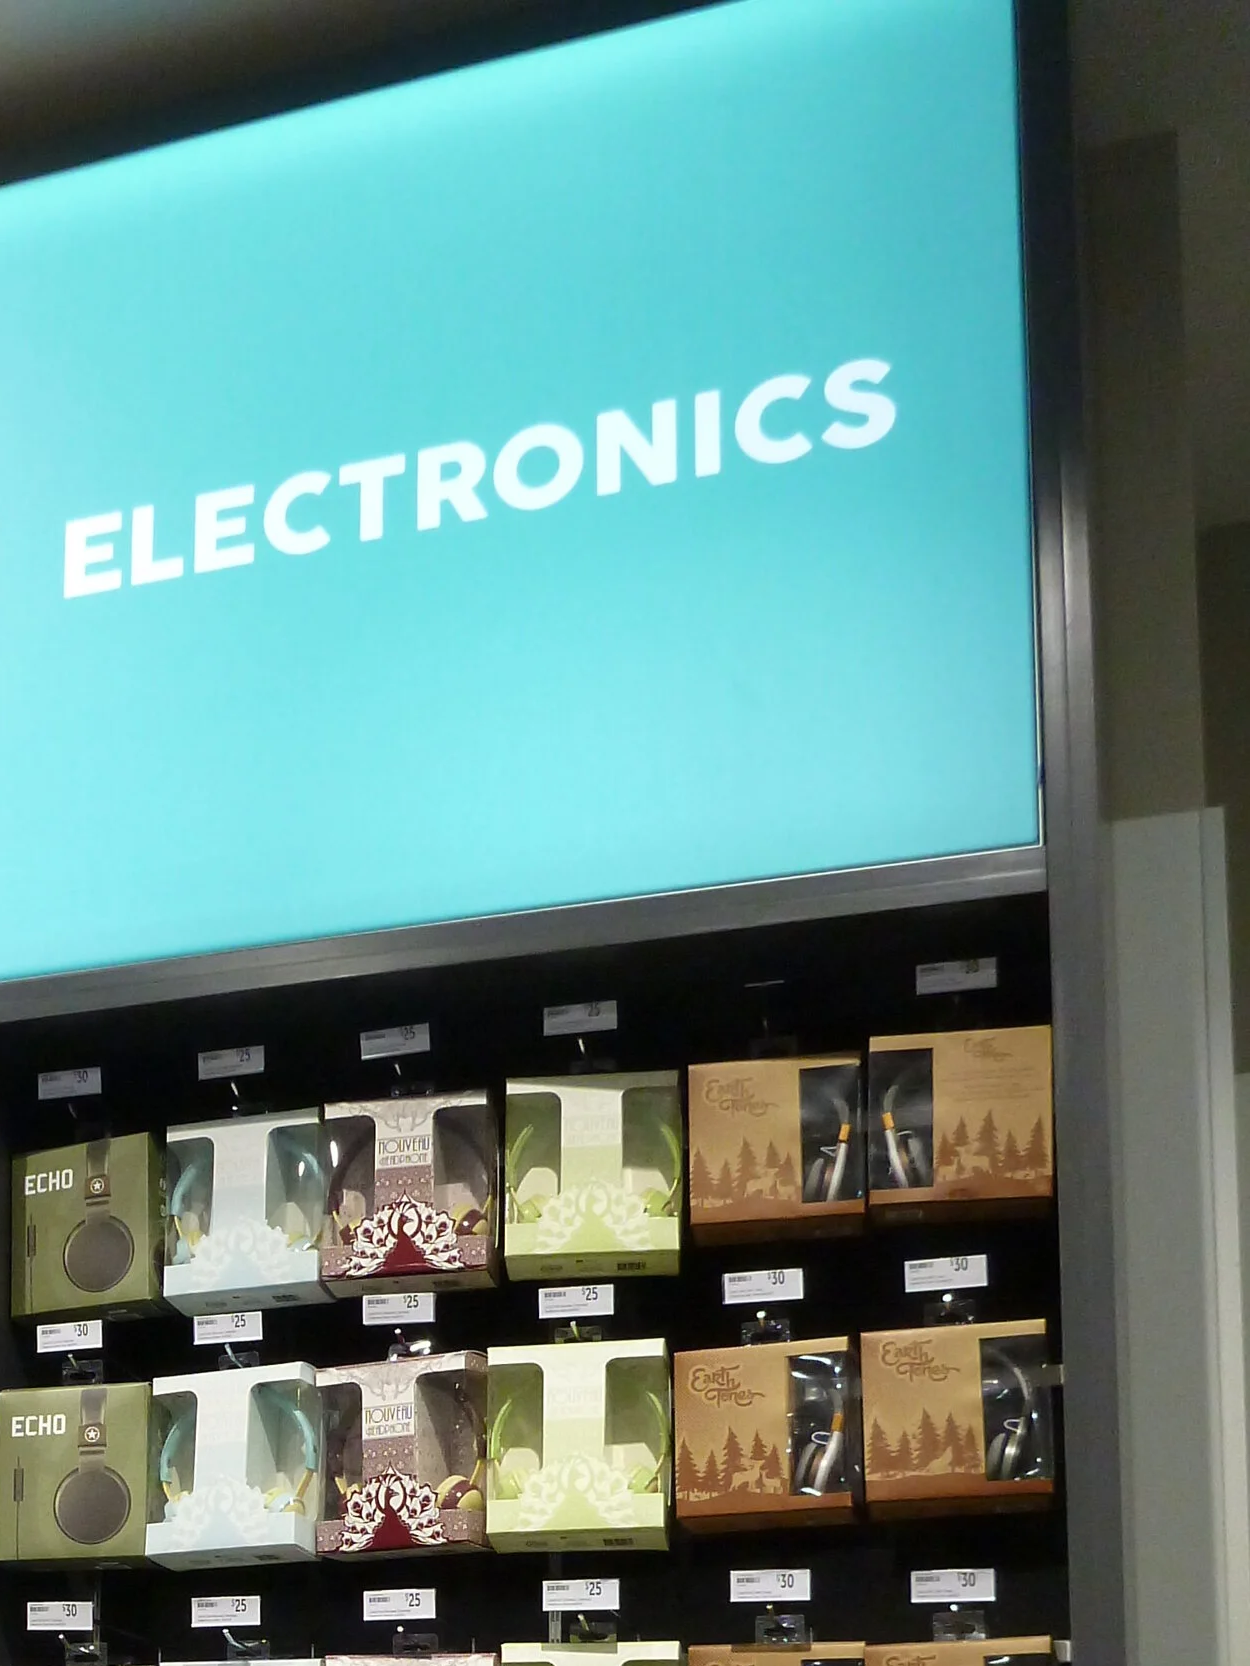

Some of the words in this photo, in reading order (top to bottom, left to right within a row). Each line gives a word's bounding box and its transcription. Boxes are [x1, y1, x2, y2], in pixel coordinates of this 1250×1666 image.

[63, 358, 898, 599] ELECTRONICS
[378, 1137, 430, 1155] NOUVEAU
[24, 1168, 74, 1197] ECHO
[767, 1270, 785, 1285] $30
[582, 1286, 598, 1301] $25
[403, 1295, 419, 1309] $25
[231, 1314, 246, 1328] $25
[73, 1323, 89, 1337] $30
[881, 1340, 935, 1364] Earth
[691, 1366, 741, 1390] Earth
[896, 1362, 961, 1382] Tones
[705, 1387, 765, 1408] Tones
[365, 1402, 413, 1424] NOUVEAU
[11, 1414, 66, 1437] ECHO
[776, 1573, 794, 1589] $30
[957, 1572, 976, 1587] $30
[585, 1581, 602, 1596] $25
[231, 1598, 247, 1613] $25
[404, 1592, 421, 1607] $25
[62, 1603, 77, 1618] $30
